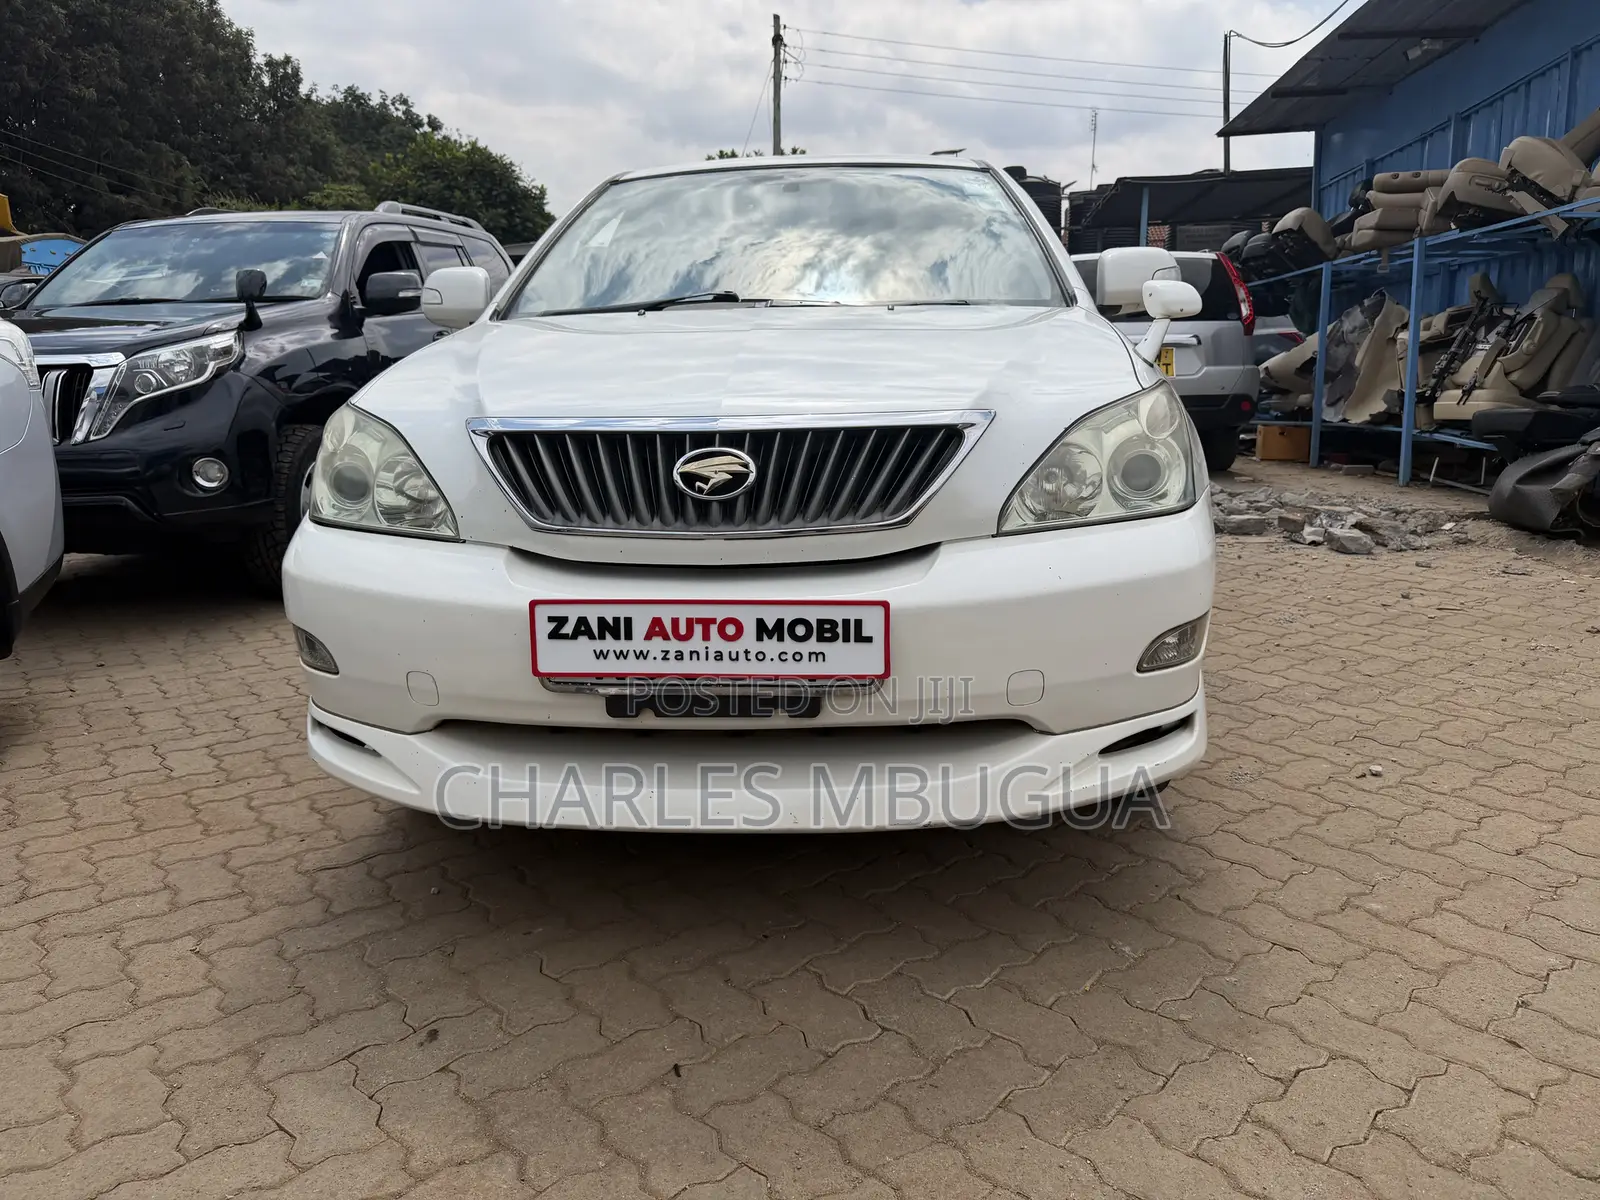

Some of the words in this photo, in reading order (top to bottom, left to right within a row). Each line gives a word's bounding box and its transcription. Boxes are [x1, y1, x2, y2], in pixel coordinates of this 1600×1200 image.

[547, 615, 633, 641] ZANI
[643, 616, 744, 643] AUTO
[755, 617, 874, 643] MOBIL
[593, 645, 826, 664] www.zaniauto.com
